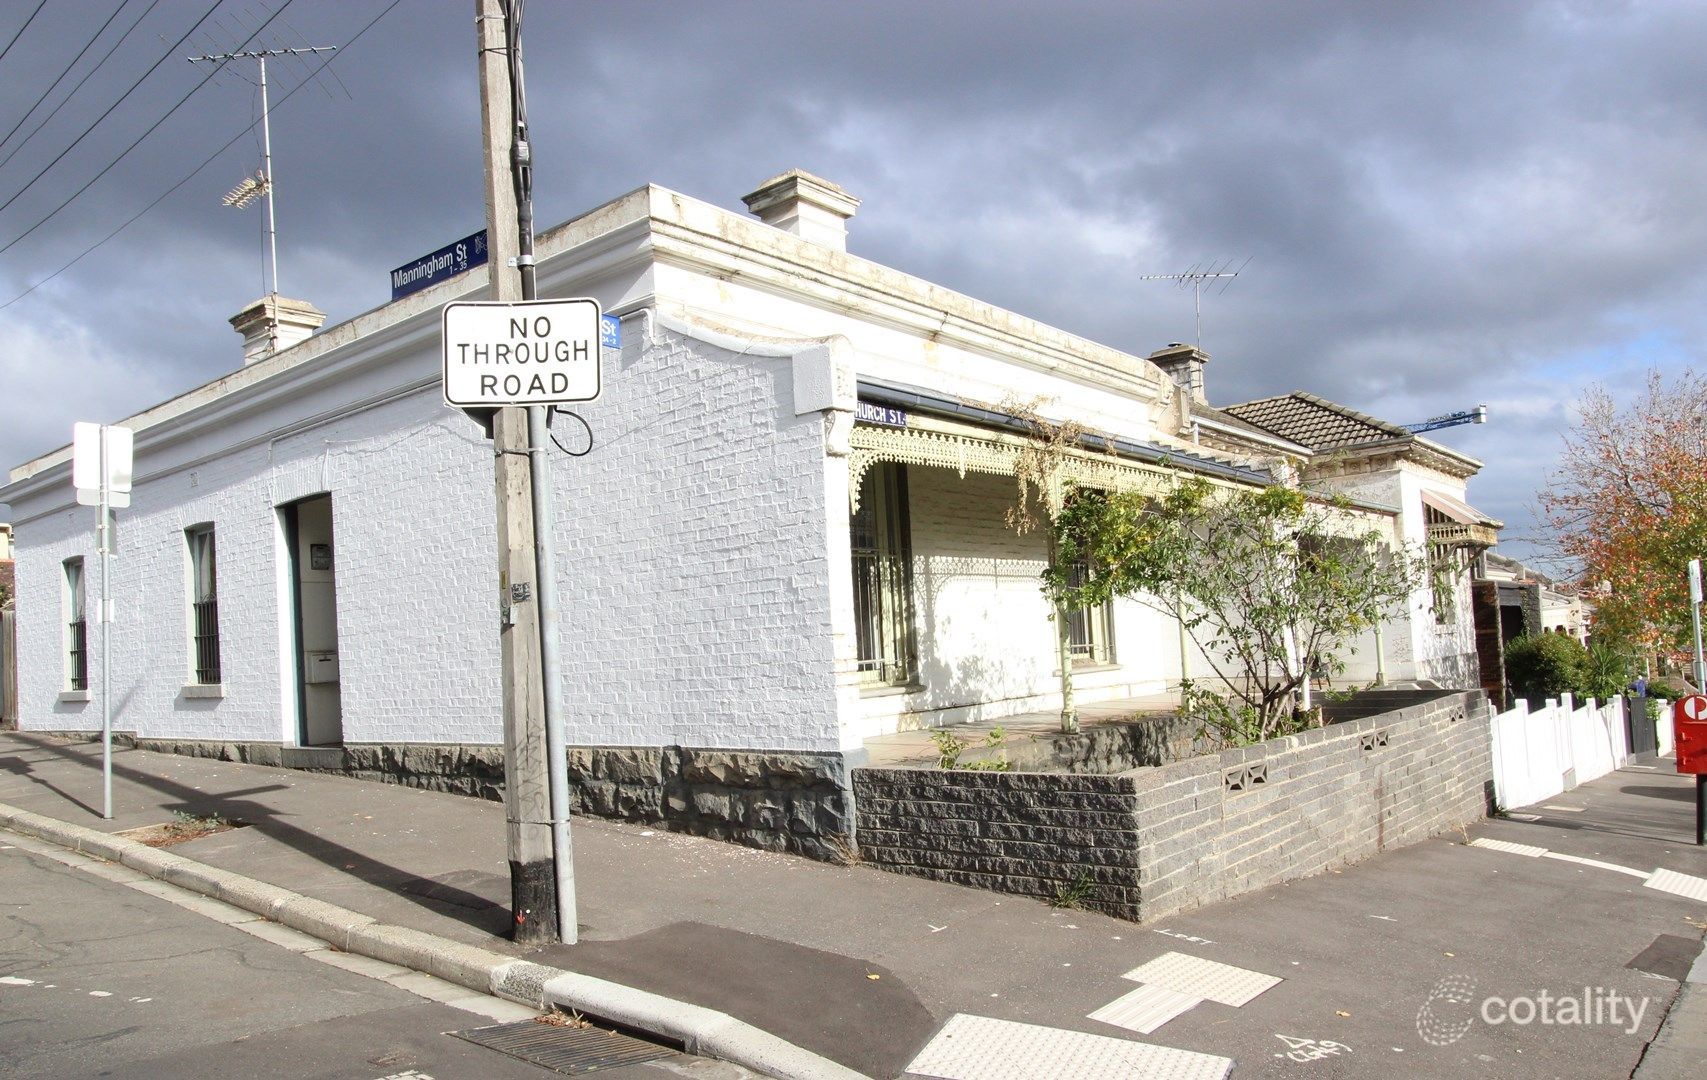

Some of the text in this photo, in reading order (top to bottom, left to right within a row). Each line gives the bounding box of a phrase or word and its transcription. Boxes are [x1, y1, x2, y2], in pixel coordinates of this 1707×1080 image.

[393, 243, 468, 289] Manningham St
[510, 316, 551, 339] NO
[602, 319, 617, 337] St
[457, 339, 588, 365] THROUGH
[480, 372, 569, 396] ROAD
[855, 402, 887, 422] HURCH
